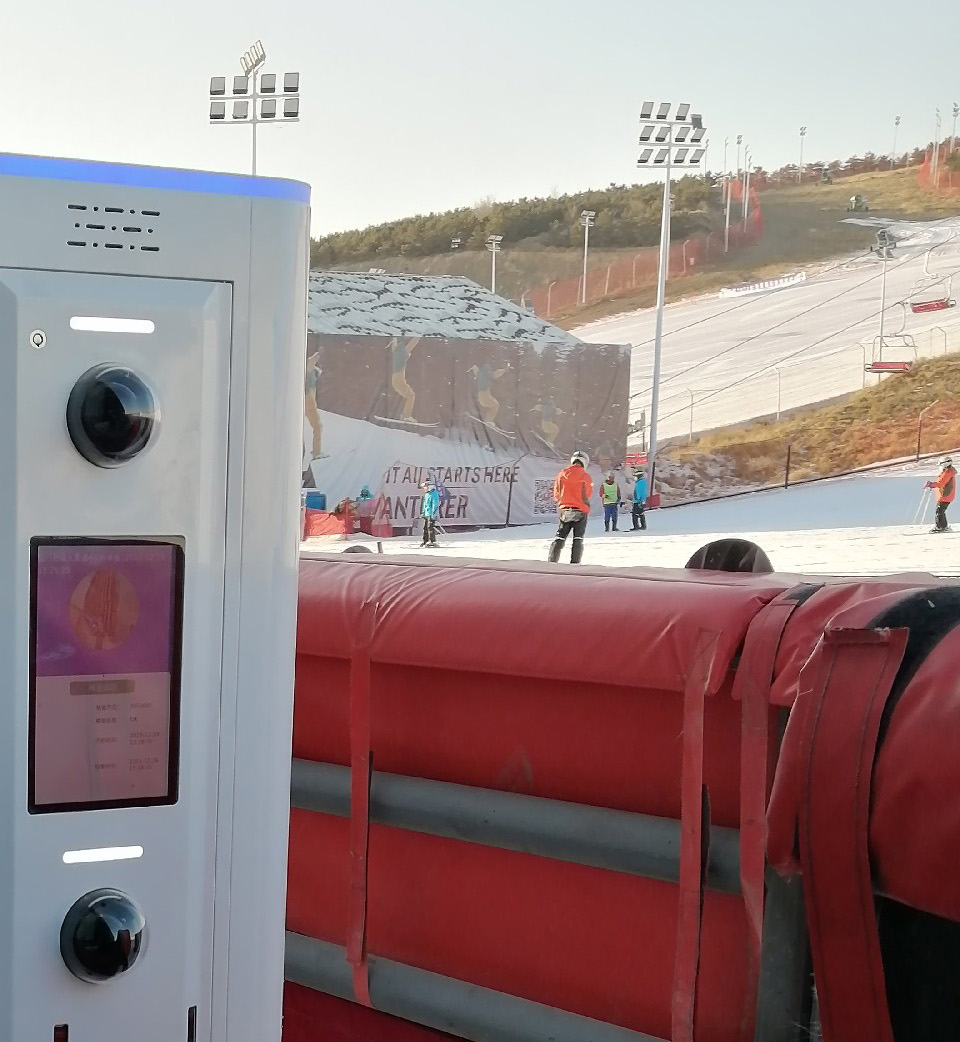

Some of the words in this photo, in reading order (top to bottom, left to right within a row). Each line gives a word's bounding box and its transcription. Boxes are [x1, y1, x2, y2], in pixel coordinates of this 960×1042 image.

[385, 466, 401, 484] IT
[426, 466, 481, 484] STARTS
[483, 466, 521, 484] HERE
